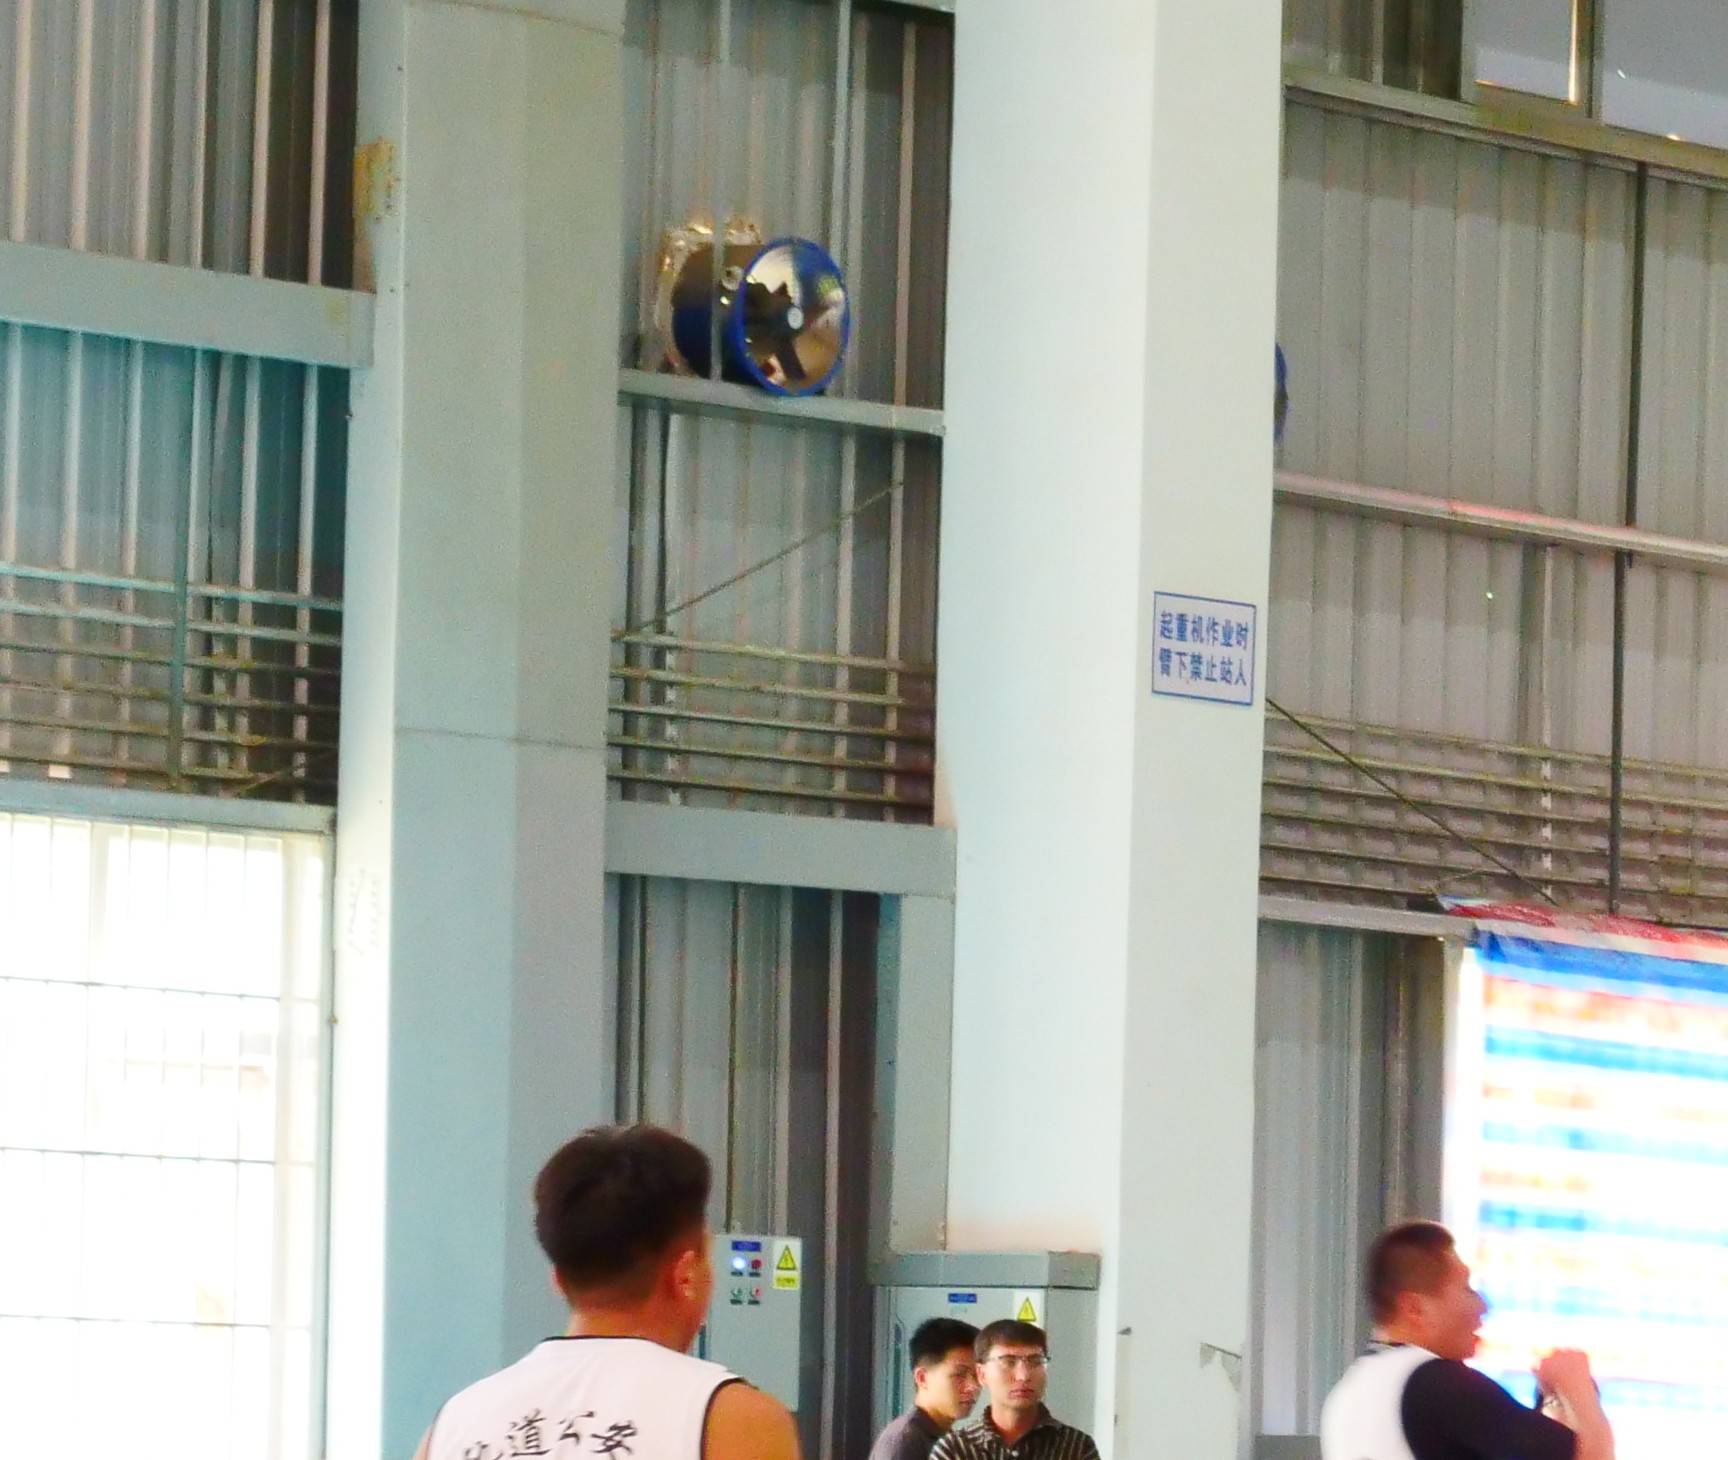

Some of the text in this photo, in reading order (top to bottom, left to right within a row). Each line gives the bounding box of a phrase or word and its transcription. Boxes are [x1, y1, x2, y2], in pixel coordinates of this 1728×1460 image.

[1159, 610, 1248, 651] 起重机作业时
[1159, 646, 1247, 686] 臂下禁止站人
